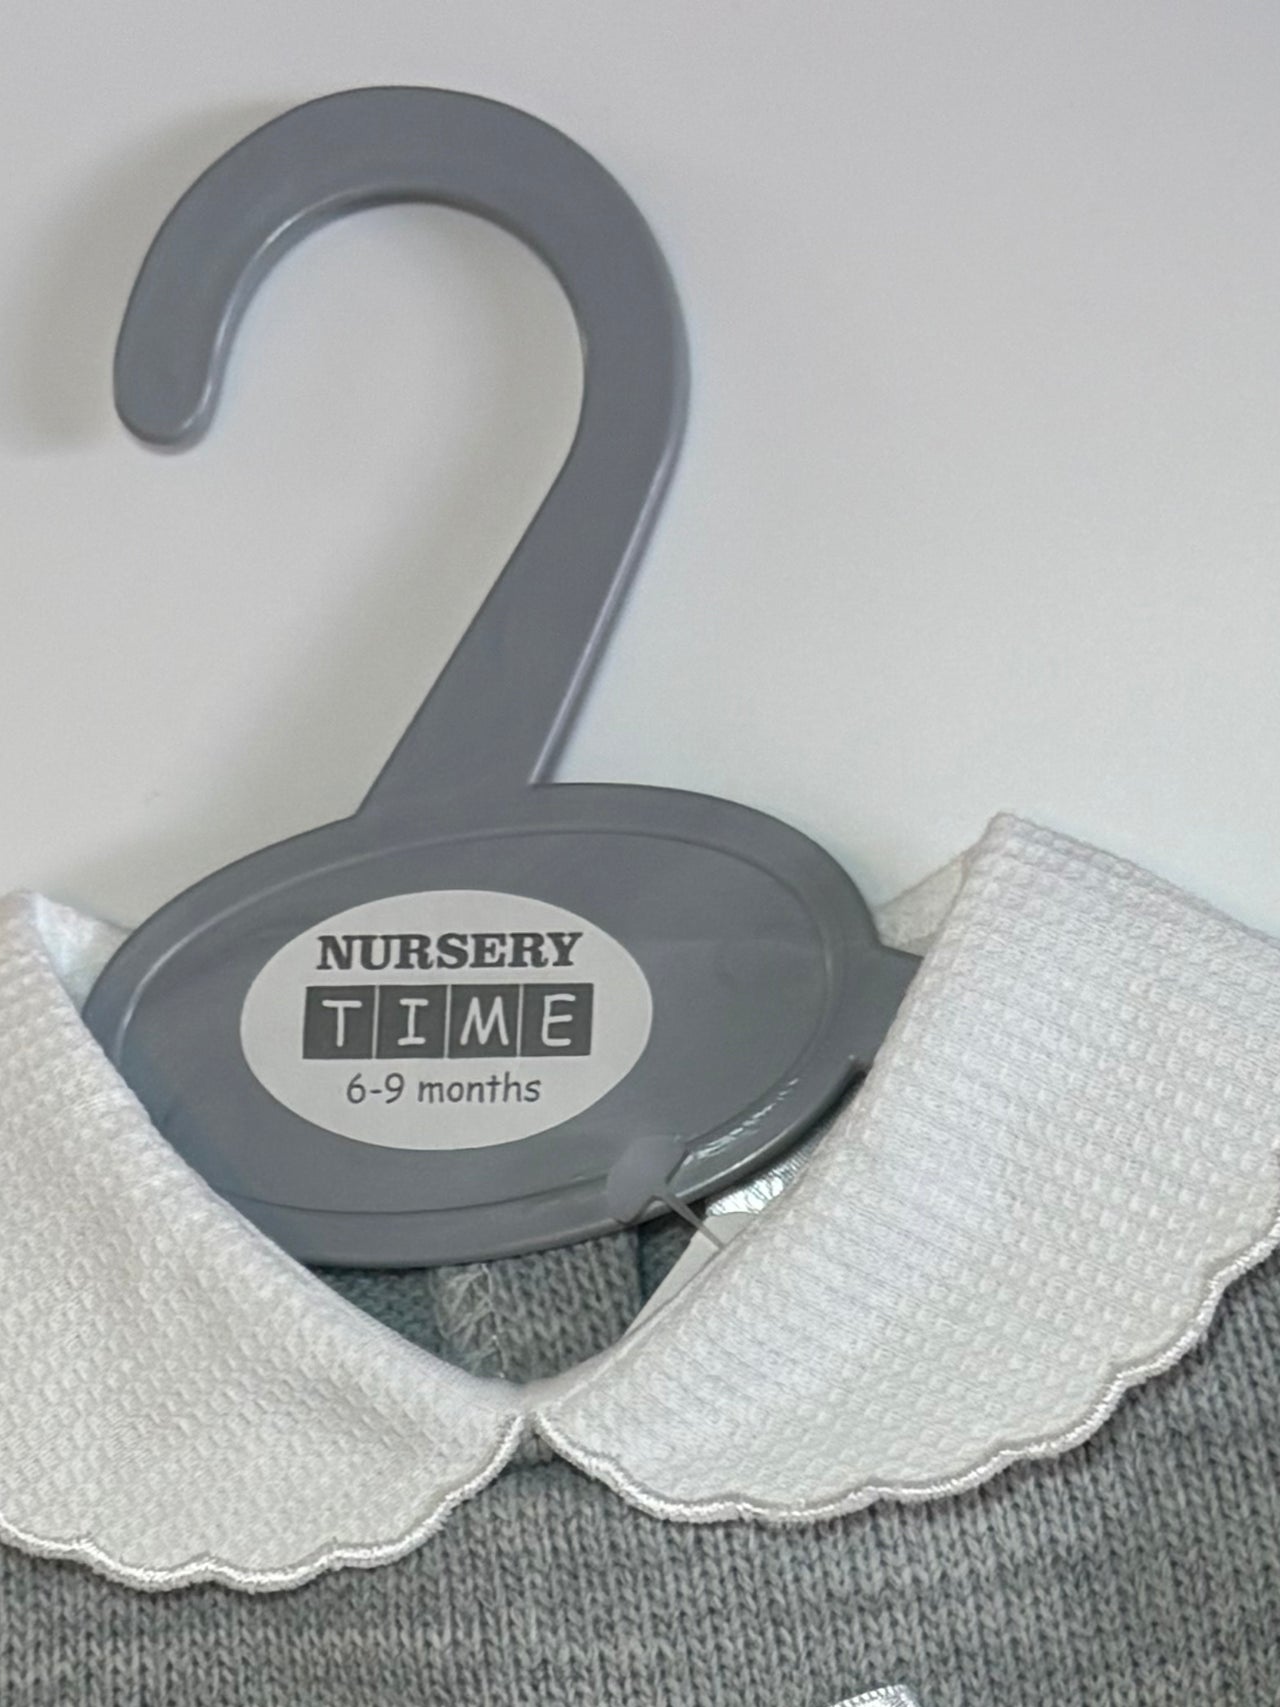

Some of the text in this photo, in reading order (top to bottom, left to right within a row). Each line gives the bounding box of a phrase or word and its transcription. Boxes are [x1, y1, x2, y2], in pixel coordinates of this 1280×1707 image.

[315, 931, 584, 971] NURSERY
[320, 992, 578, 1048] TIME
[345, 1070, 543, 1105] 6-9 months
